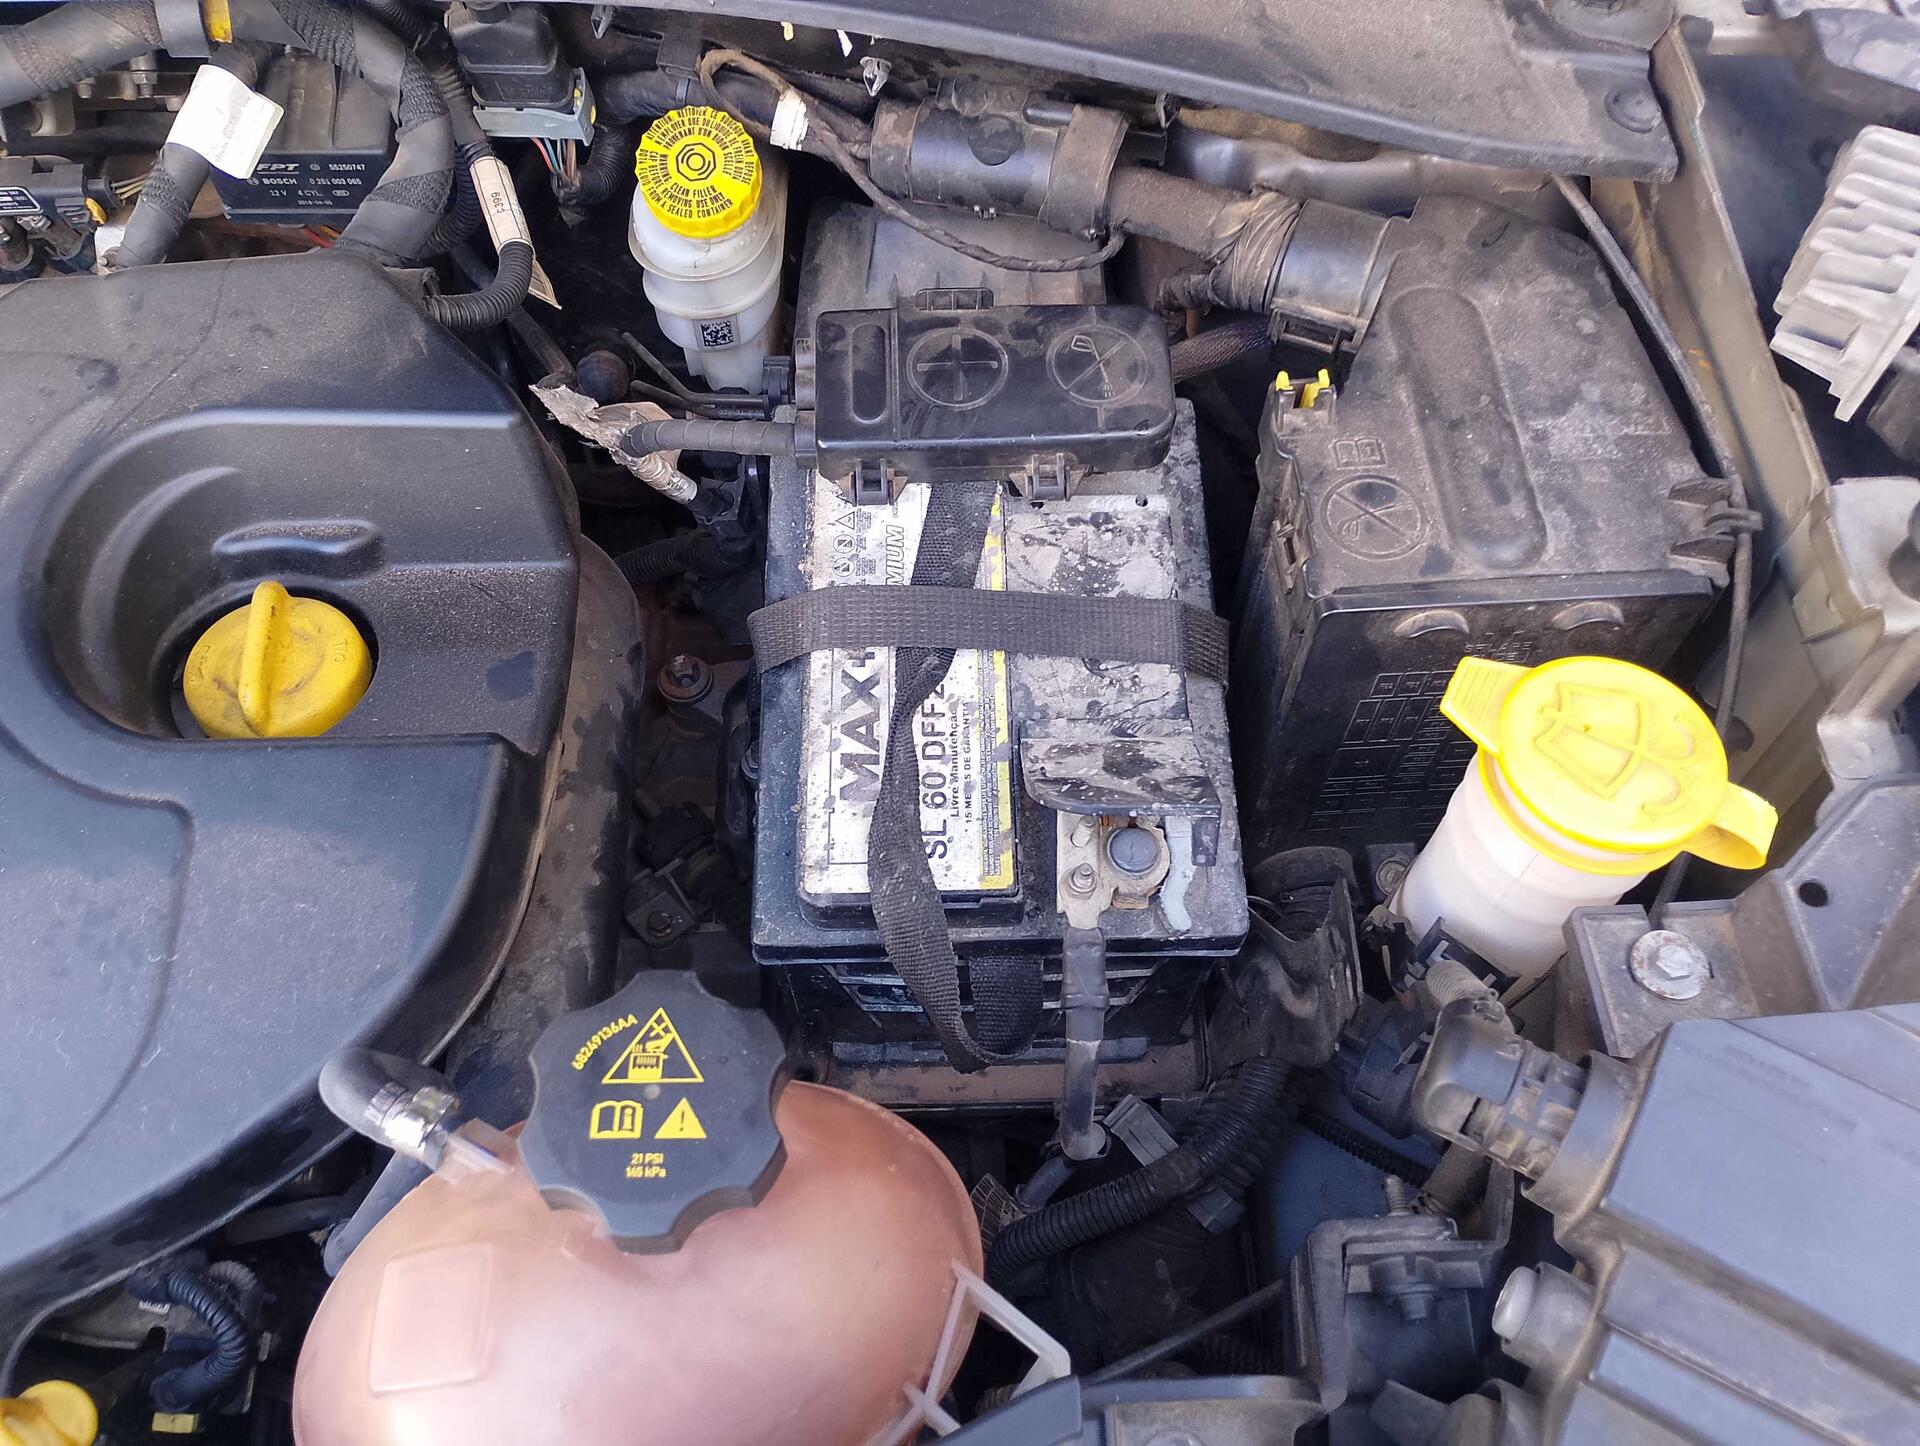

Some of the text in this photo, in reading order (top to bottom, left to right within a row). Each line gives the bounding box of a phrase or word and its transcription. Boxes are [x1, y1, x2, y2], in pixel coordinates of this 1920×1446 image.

[648, 151, 659, 162] CAP
[741, 138, 755, 157] AVANT
[256, 163, 300, 171] FPT
[648, 164, 664, 189] BEFORE
[638, 166, 651, 186] FLUID
[647, 186, 663, 205] FROM
[660, 201, 667, 209] A
[667, 203, 693, 219] SEALED
[697, 198, 734, 219] CONTAINER
[670, 182, 690, 198] CLEAN
[693, 185, 718, 198] FILLER
[709, 191, 726, 206] ONLY
[490, 191, 506, 214] C399
[695, 199, 710, 209] USE
[963, 759, 972, 772] DE
[920, 771, 948, 809] 60
[964, 773, 973, 809] MEES
[949, 793, 960, 817] Livre
[921, 818, 949, 860] SL
[571, 1013, 639, 1072] 68249136AA
[630, 1152, 664, 1165] 21 PSI
